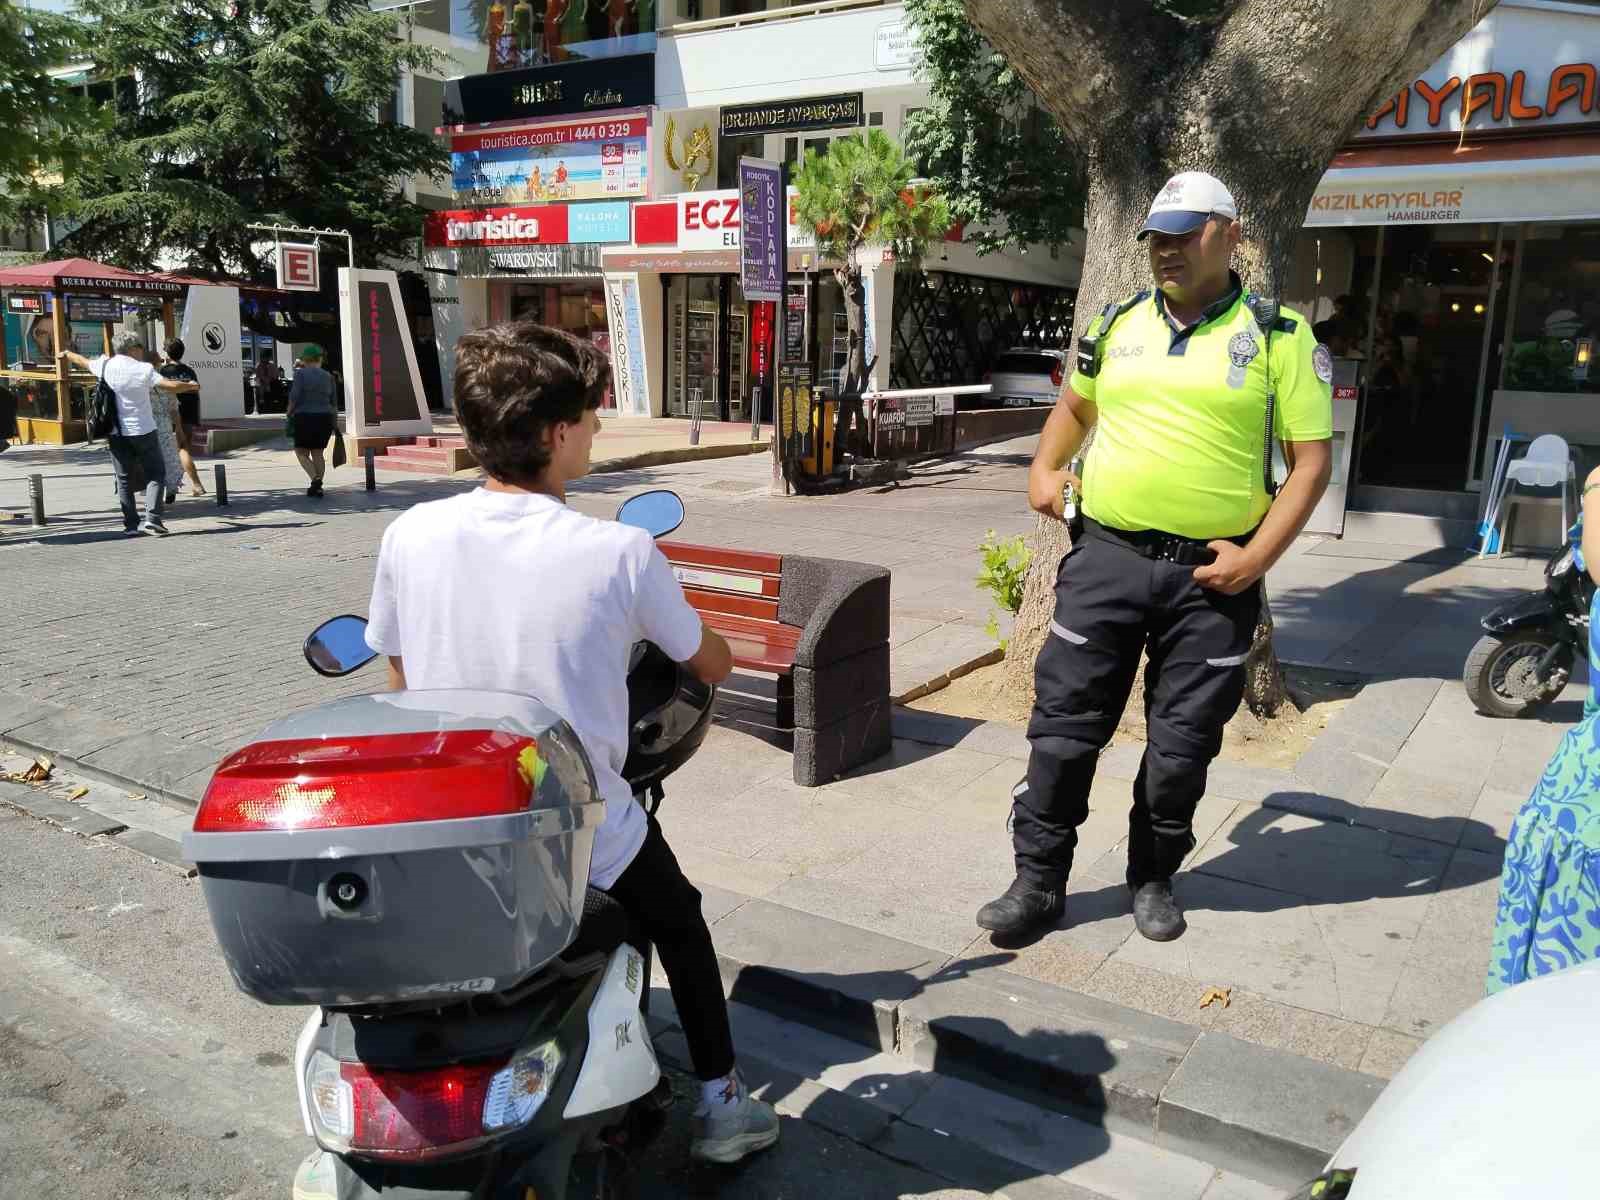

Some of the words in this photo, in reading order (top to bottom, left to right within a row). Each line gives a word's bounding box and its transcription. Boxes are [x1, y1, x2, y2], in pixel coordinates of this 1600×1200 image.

[1362, 63, 1600, 129] AYALA
[481, 127, 565, 149] touristica.com.tr
[575, 126, 596, 140] 444
[599, 125, 606, 138] 0
[608, 122, 630, 138] 329
[685, 198, 741, 230] ECZ
[1312, 191, 1463, 210] KIZILKAYALAR
[447, 213, 539, 241] touristica
[1387, 210, 1460, 221] HAMBURGER
[767, 182, 776, 280] KODLAMA
[289, 252, 311, 281] E
[489, 251, 557, 269] SWAROVSKI
[62, 278, 87, 286] BEER
[88, 279, 94, 287] &
[95, 279, 134, 289] COCTAIL
[135, 281, 142, 289] &
[613, 294, 629, 401] SWAROVSKI
[190, 360, 240, 369] SWAROVSKI
